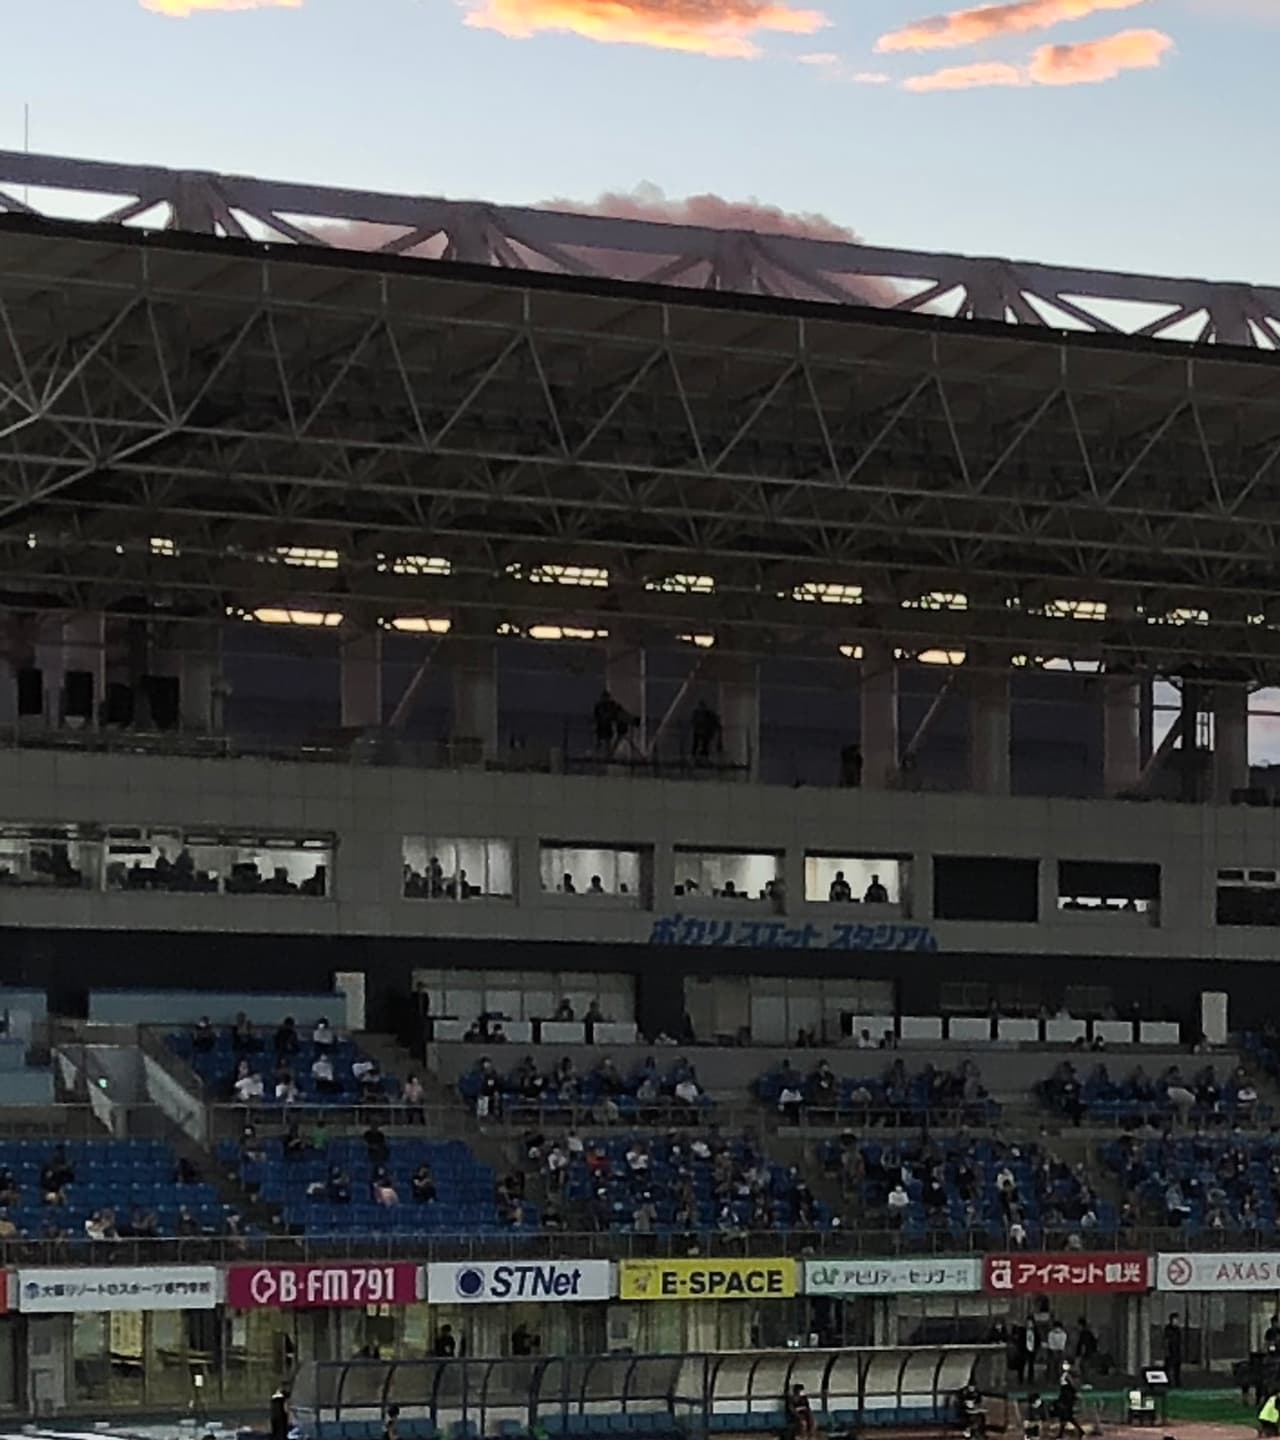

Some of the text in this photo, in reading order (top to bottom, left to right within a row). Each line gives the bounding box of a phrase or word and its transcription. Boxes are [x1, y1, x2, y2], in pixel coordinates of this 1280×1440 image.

[490, 1266, 582, 1299] STNet
[661, 1269, 783, 1295] E-SPACE
[1017, 1262, 1141, 1284] アイネット観光
[1216, 1262, 1270, 1280] AXAS
